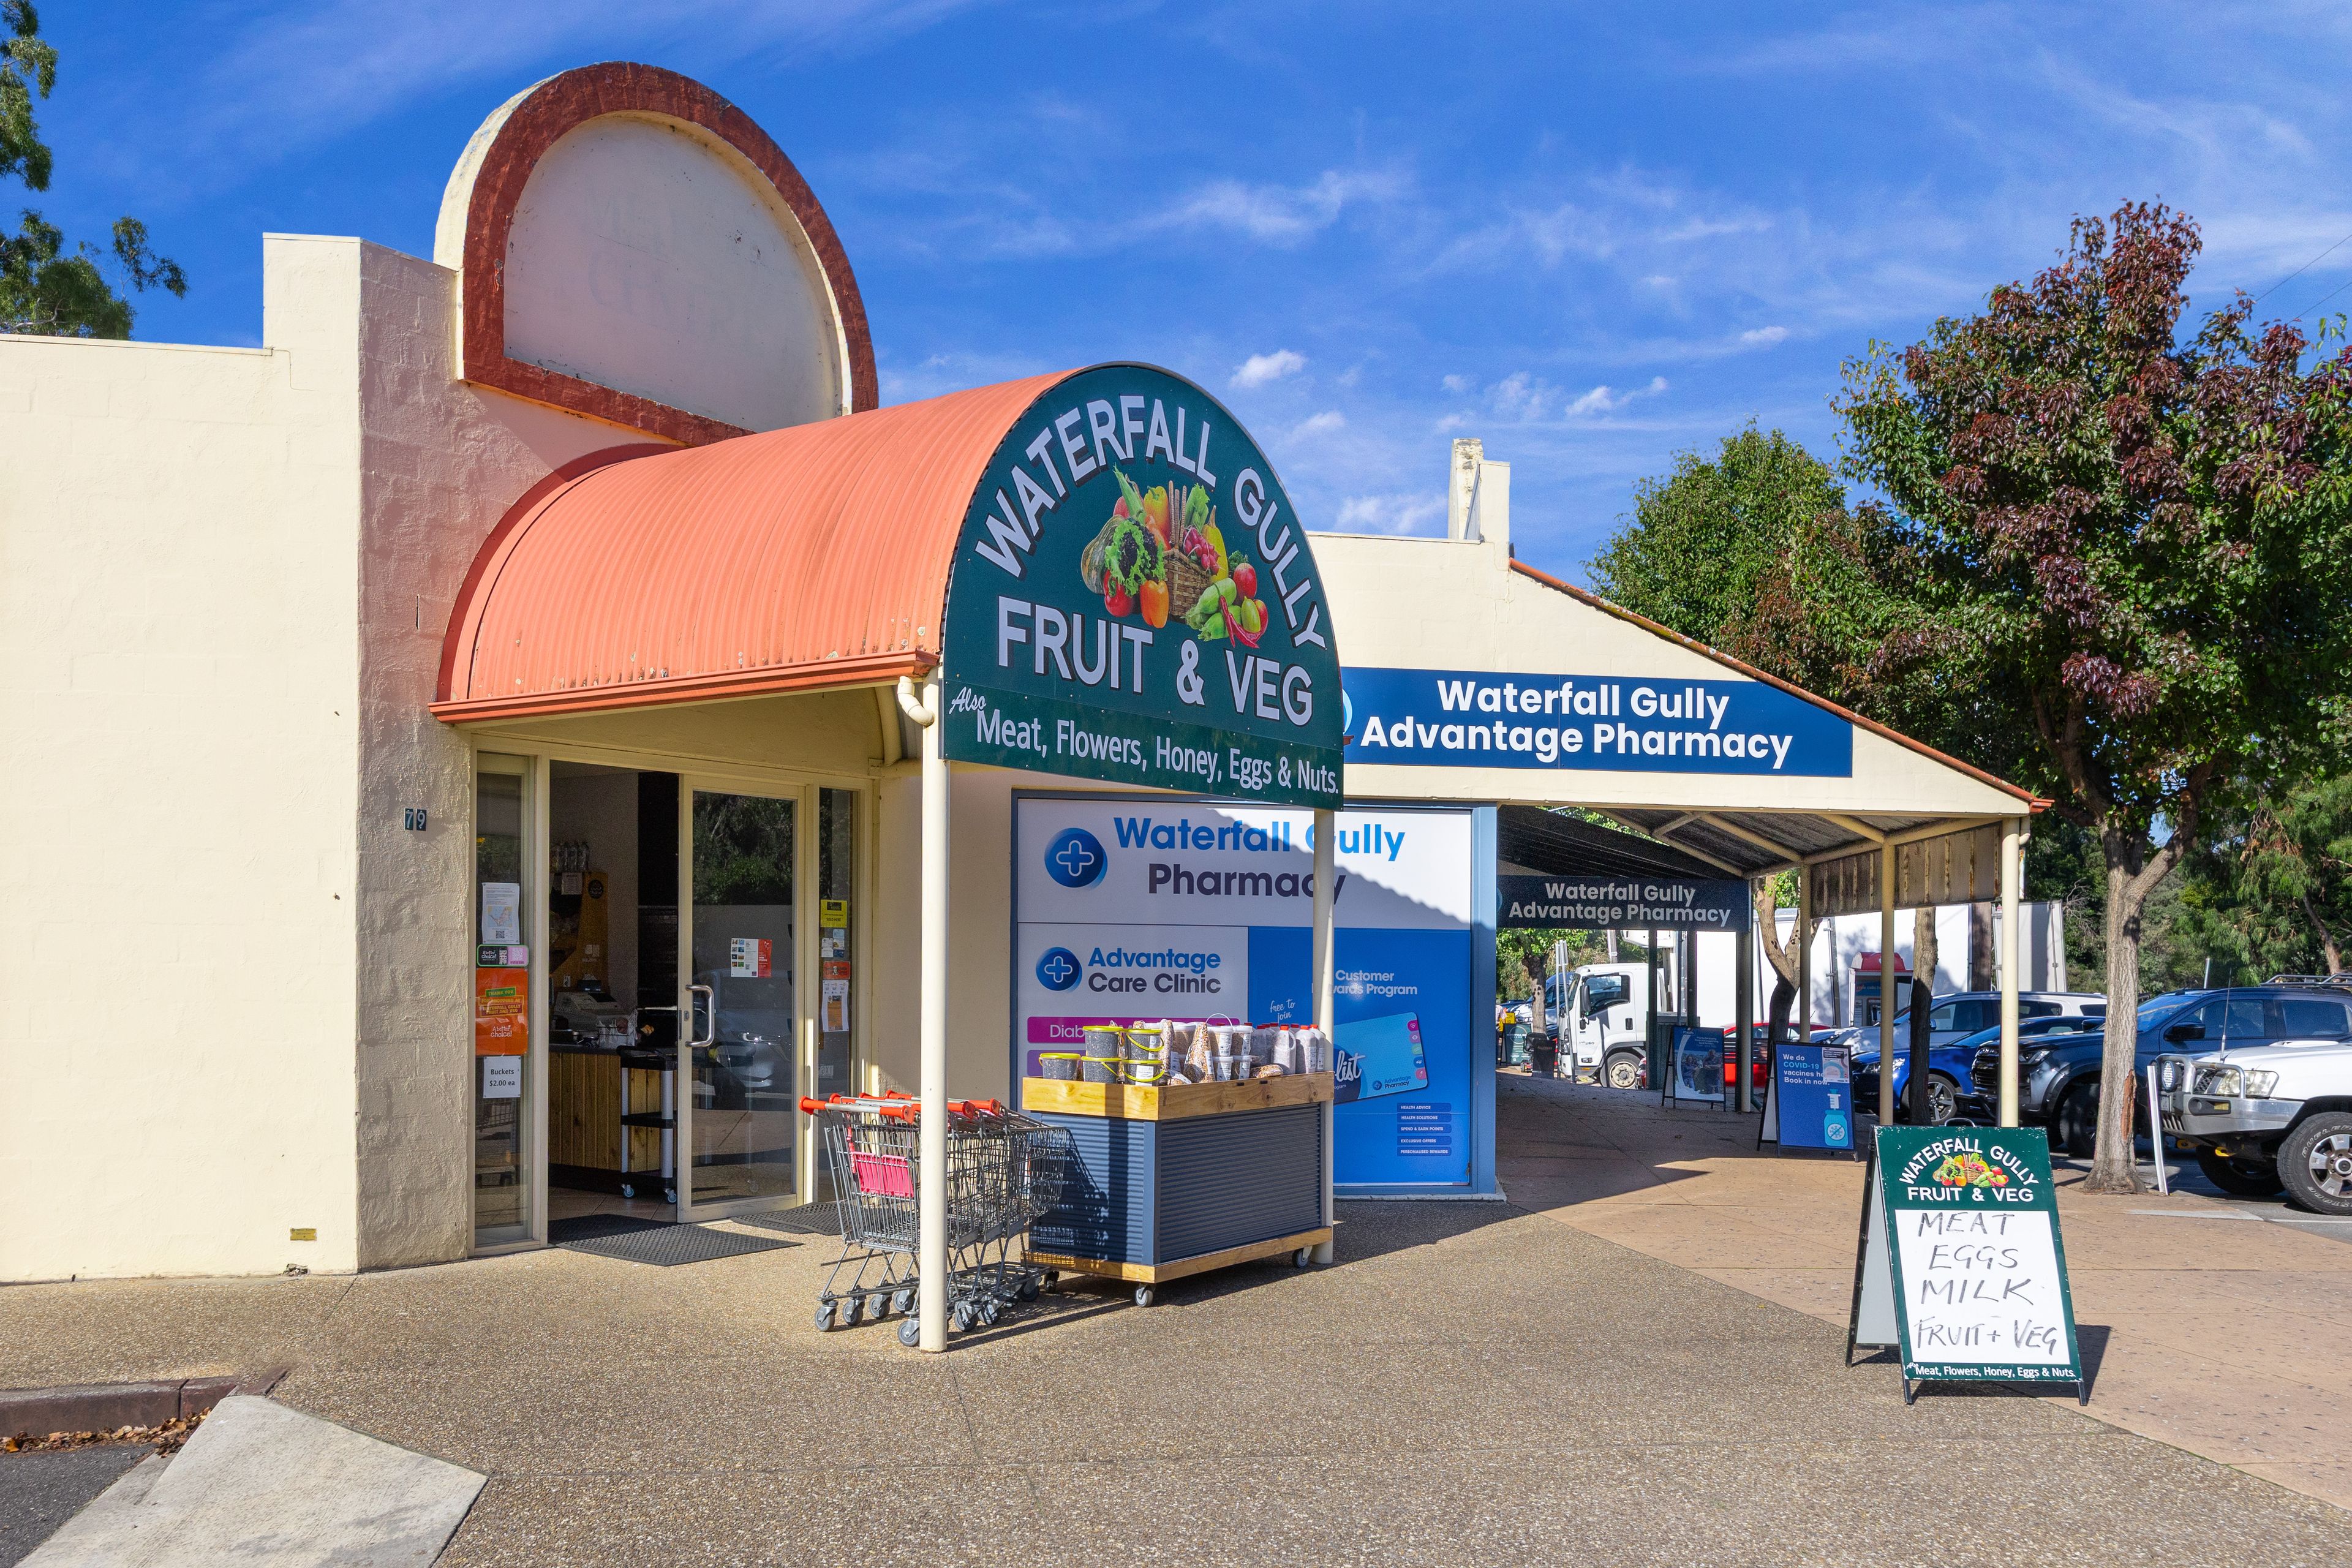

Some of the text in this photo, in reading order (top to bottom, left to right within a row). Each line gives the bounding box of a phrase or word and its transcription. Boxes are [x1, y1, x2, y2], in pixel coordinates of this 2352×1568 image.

[974, 393, 1327, 650] WATERFALL GULLY
[998, 595, 1313, 726] FRUIT & VEG
[949, 686, 987, 715] Also
[1438, 680, 1730, 730] Waterfall Gully
[976, 709, 1340, 794] Meat, Flowers, Honey, Eggs & Nuts.
[1360, 715, 1793, 769] Advantage Pharmacy
[406, 812, 426, 828] 79
[1114, 817, 1291, 852] Waterfall
[1545, 883, 1696, 907] Waterfall Gully
[1509, 902, 1731, 928] Advantage Pharmacy
[1088, 947, 1221, 974] Advantage
[1088, 973, 1221, 994] Care Clinic
[1335, 970, 1395, 981] Customer
[1366, 984, 1418, 998] Program
[1270, 998, 1295, 1013] free to
[1277, 1011, 1292, 1022] join
[1384, 1080, 1410, 1089] Pharmacy
[1899, 1137, 2039, 1186] WATERFALL GULLY
[1907, 1187, 2034, 1202] FRUIT & VEG
[1918, 1212, 2015, 1237] MEAT
[1928, 1245, 2019, 1270] EGGS
[1920, 1278, 2034, 1306] MILK
[1913, 1316, 1985, 1349] FRUIT
[2014, 1319, 2058, 1355] VEG
[1915, 1366, 2076, 1379] Meat, Flowers, Honey, Eggs & Nuts.
